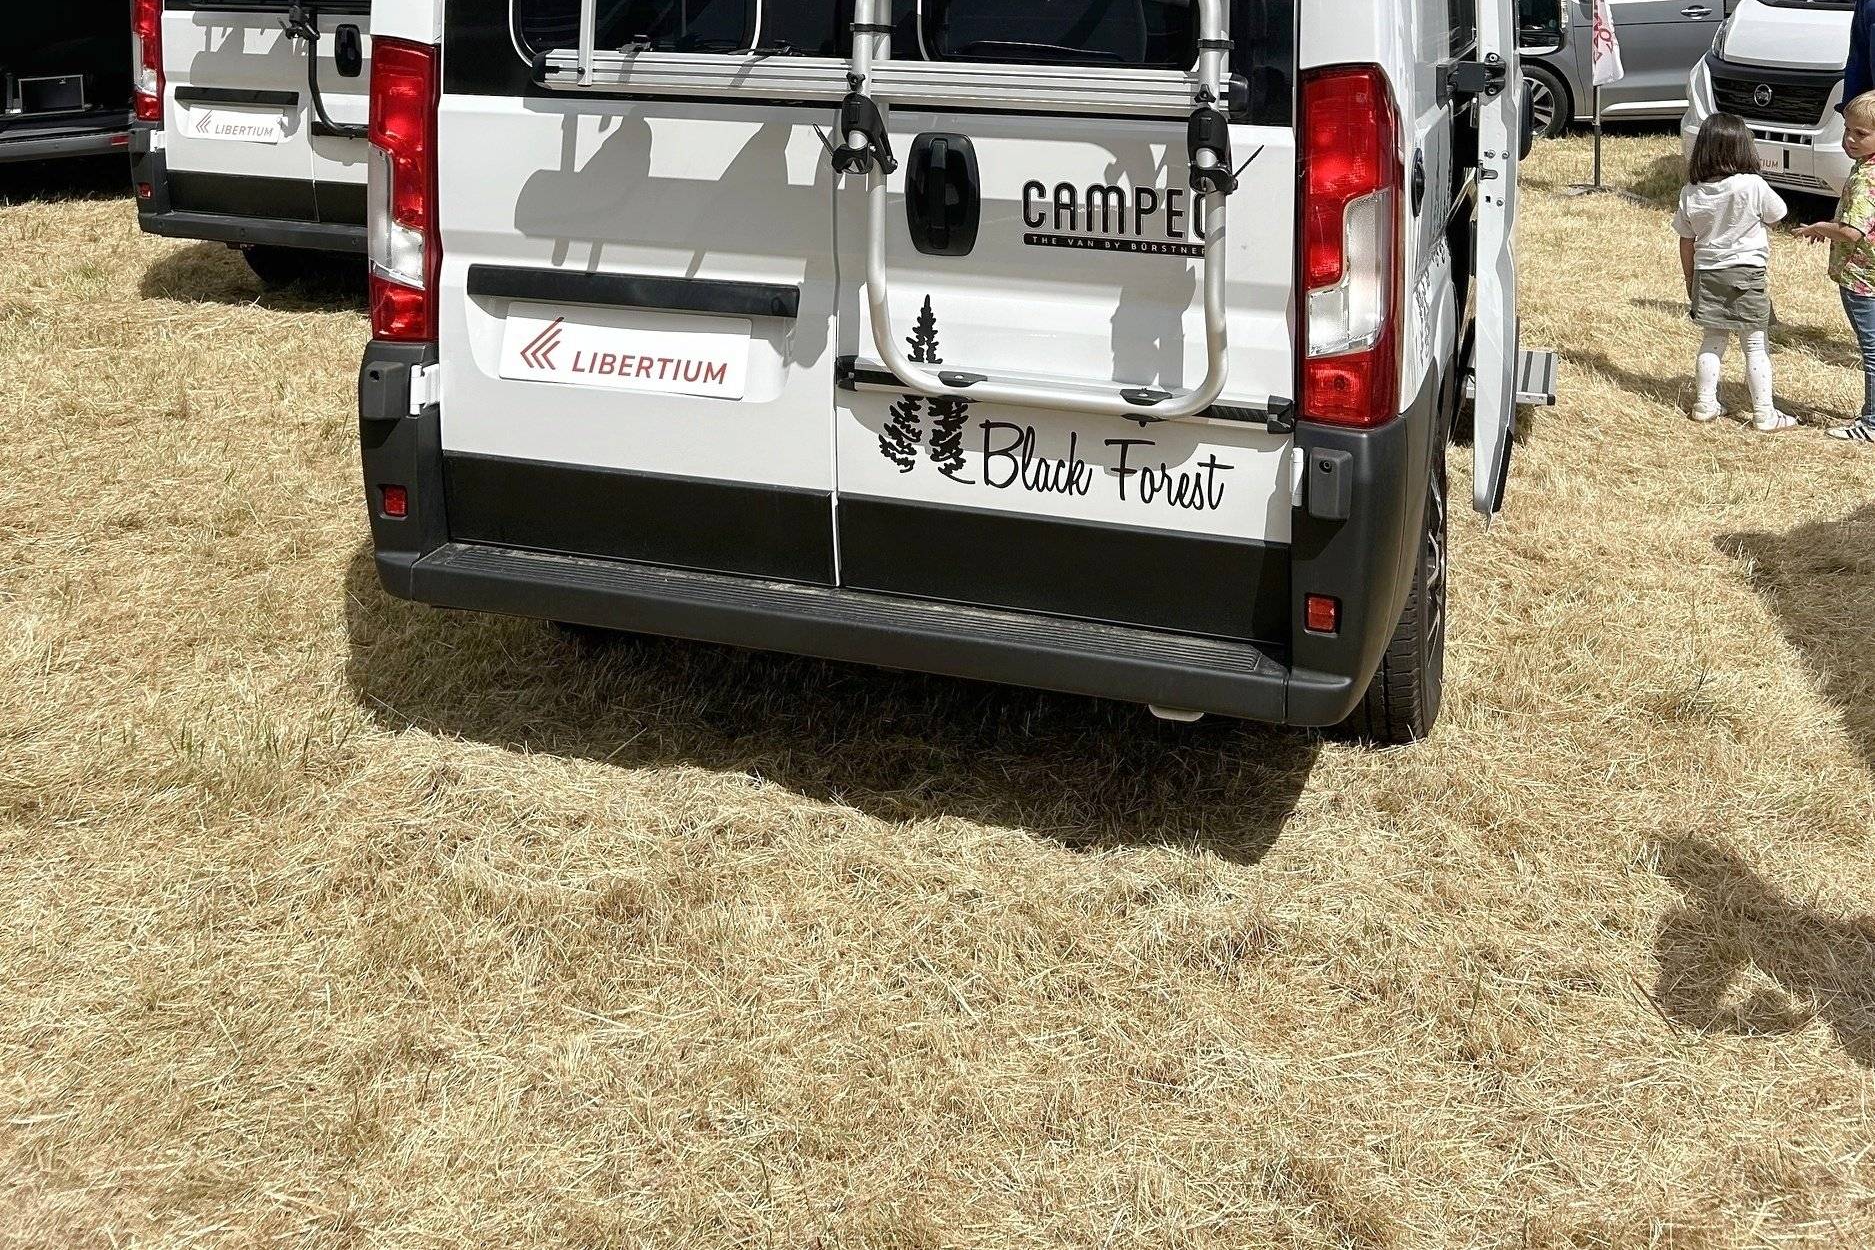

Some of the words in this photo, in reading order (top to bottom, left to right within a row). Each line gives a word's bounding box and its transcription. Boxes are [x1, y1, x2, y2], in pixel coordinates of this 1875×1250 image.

[215, 124, 273, 137] LIBERTIUM
[1032, 236, 1057, 245] THE
[1067, 238, 1094, 248] VAN
[1104, 241, 1120, 249] BY
[571, 350, 728, 385] LIBERTIUM
[978, 418, 1093, 496] Black
[1104, 438, 1235, 511] Forest
